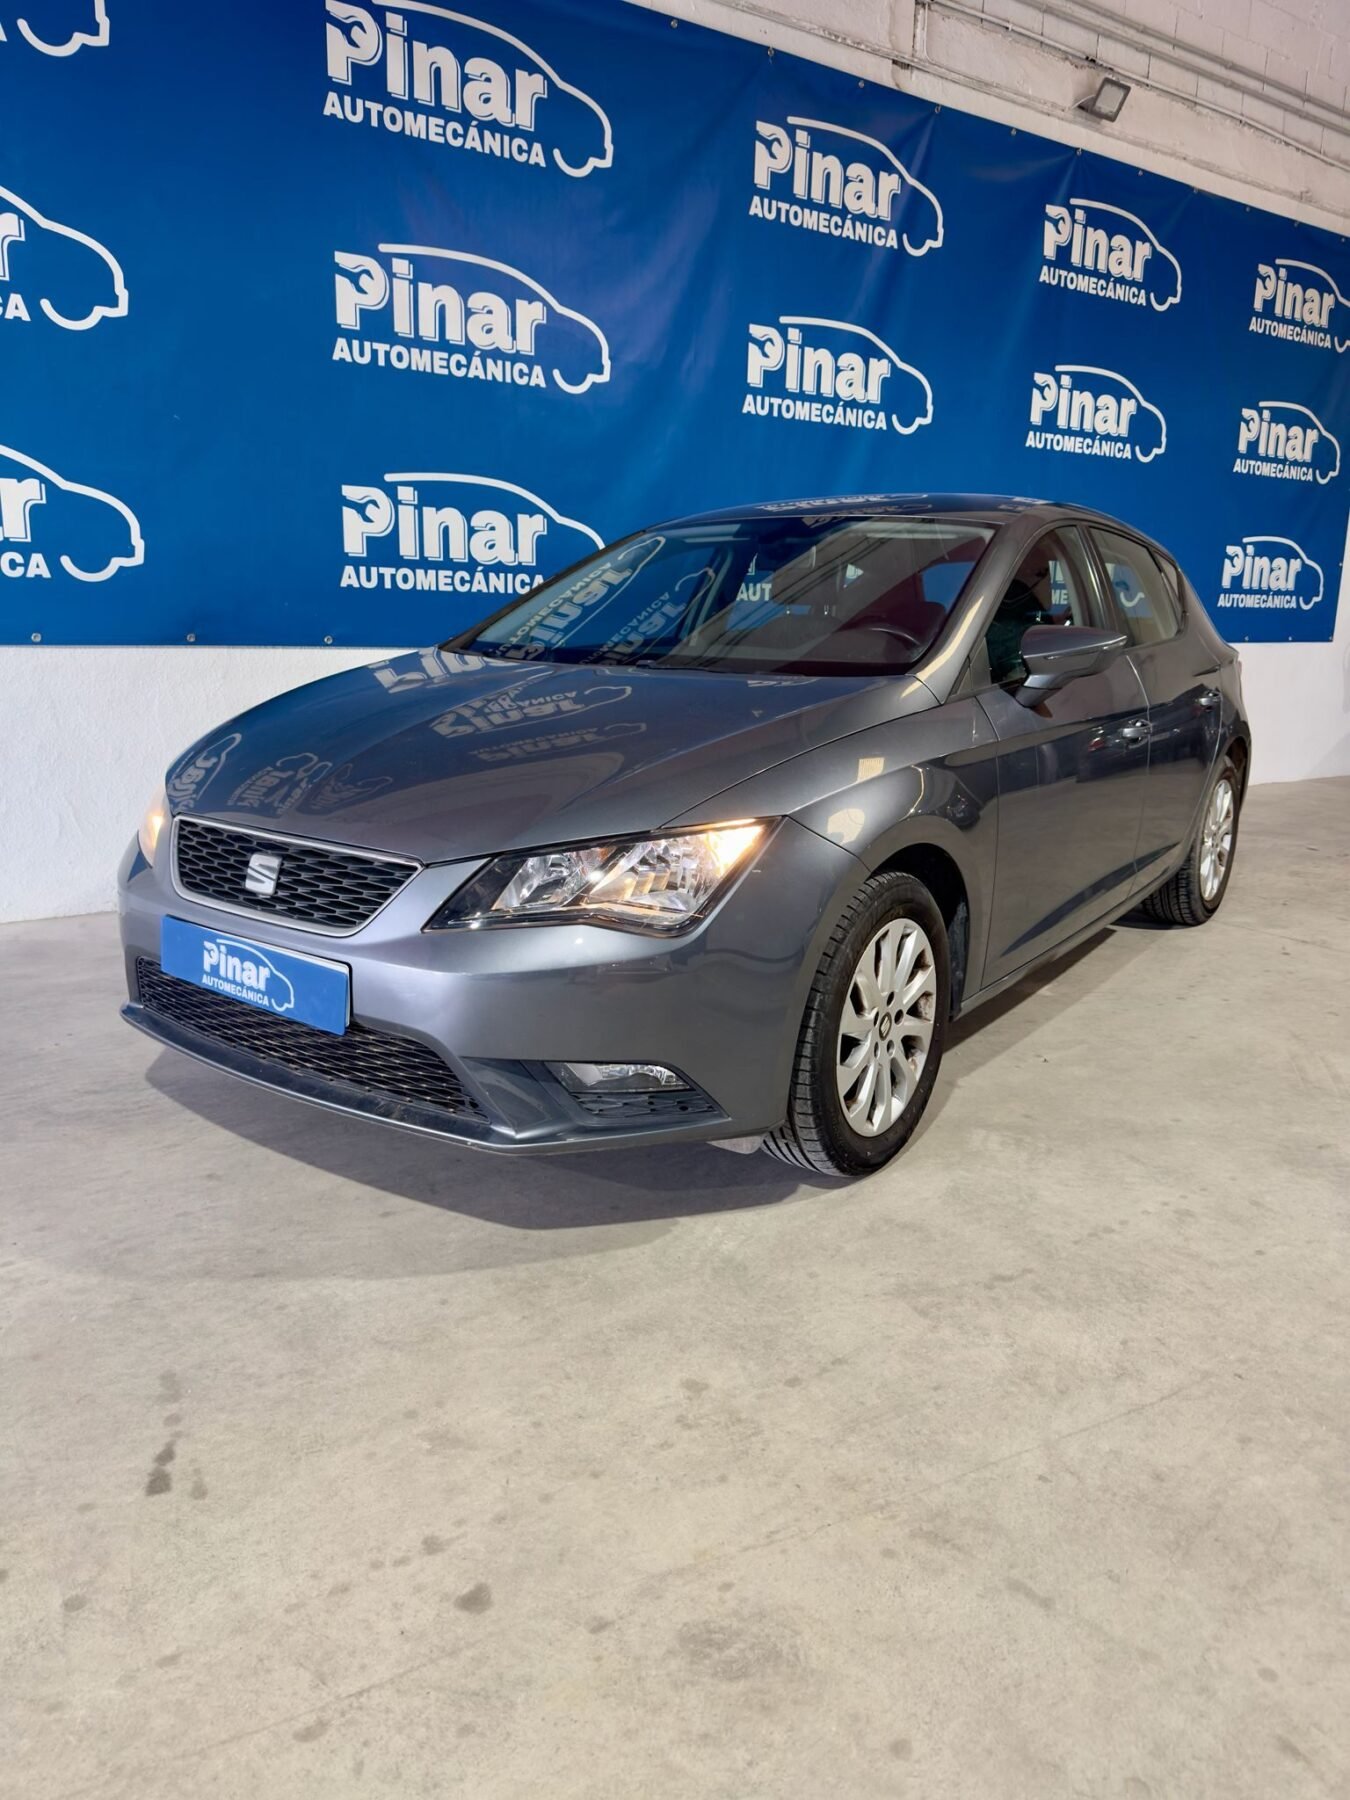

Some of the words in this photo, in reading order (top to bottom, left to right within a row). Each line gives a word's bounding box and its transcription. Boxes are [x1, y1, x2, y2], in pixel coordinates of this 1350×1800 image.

[325, 0, 548, 132] Pinar
[323, 91, 546, 168] AUTOMECÁNICA
[753, 119, 902, 222] Pinar
[749, 195, 899, 249] AUTOMECÁNICA
[1043, 203, 1152, 283] Pinar
[334, 250, 547, 356] Pinar
[1039, 265, 1147, 306] AUTOMECÁNICA
[1253, 263, 1335, 329] Pinar
[1249, 316, 1332, 349] AUTOMECÁNICA
[332, 337, 547, 388] AUTOMECÁNICA
[746, 323, 892, 404] Pinar
[742, 394, 888, 430] AUTOMECÁNICA
[1030, 371, 1138, 438] Pinar
[1025, 431, 1132, 460] AUTOMECÁNICA
[1237, 407, 1319, 463] Pinar
[1233, 458, 1313, 482] AUTOMECÁNICA
[341, 484, 548, 566] Pinar
[1221, 544, 1302, 591] Pinar
[1217, 592, 1297, 609] AUTOMECÁNICA
[201, 974, 269, 1007] AUTOMECÁNICA
[203, 940, 271, 992] Pinar
